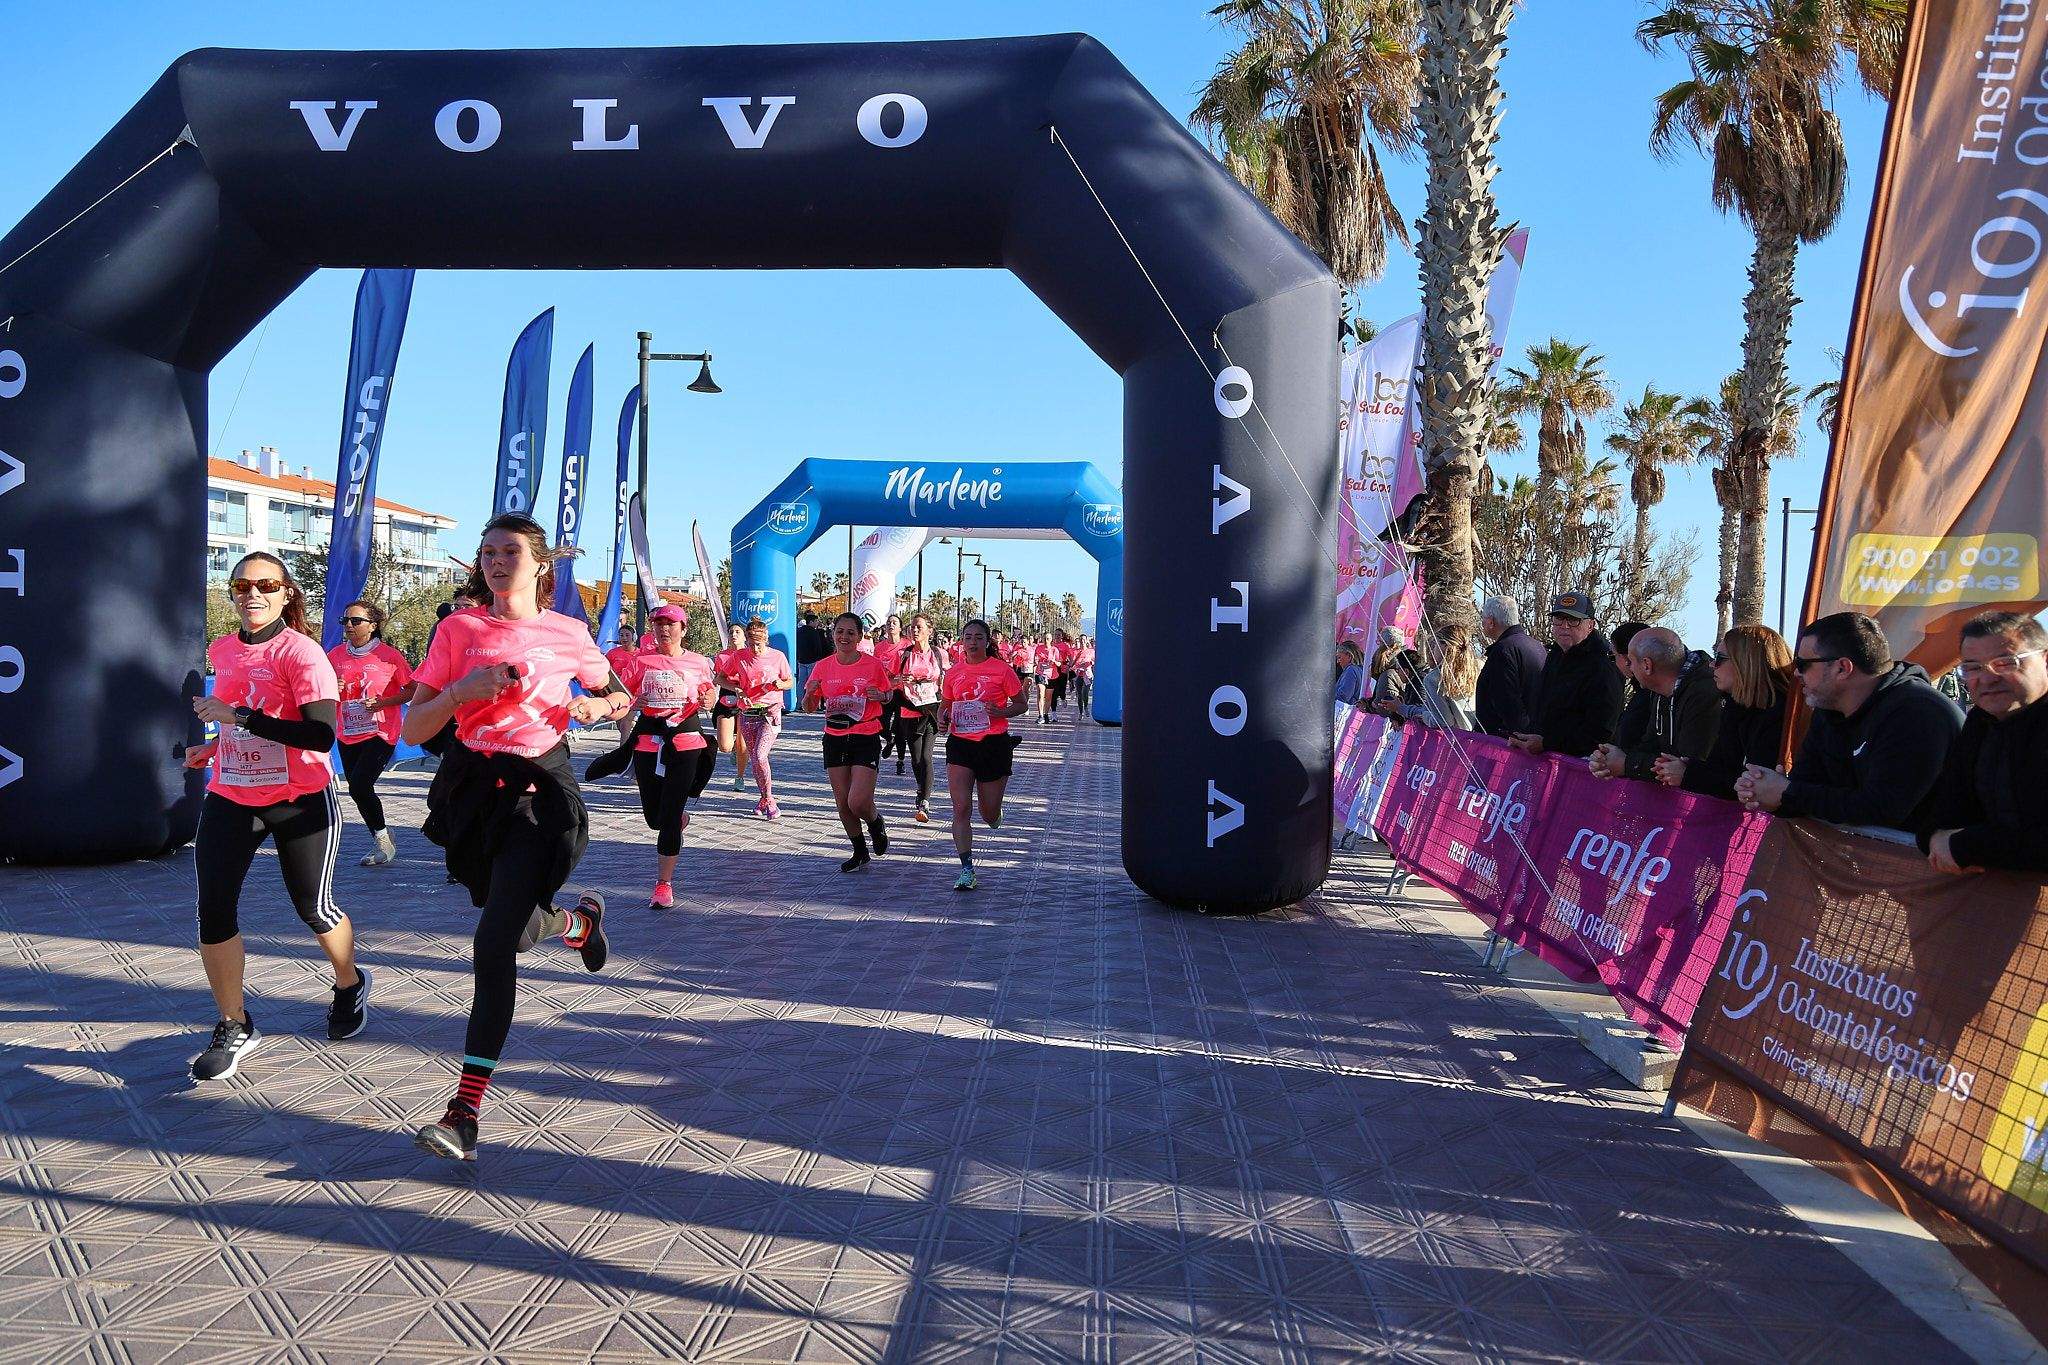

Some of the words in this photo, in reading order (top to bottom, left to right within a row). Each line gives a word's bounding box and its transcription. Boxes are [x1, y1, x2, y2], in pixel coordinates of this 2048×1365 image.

[289, 92, 928, 153] VOLVO
[504, 432, 526, 513] OYA
[884, 466, 1002, 518] Marlene
[1345, 478, 1367, 492] Sal
[770, 508, 806, 526] Marlene
[1085, 510, 1121, 528] Marlene
[1863, 546, 1916, 570] 900
[1960, 547, 2020, 568] 002
[739, 598, 776, 618] Marlene
[1207, 366, 1254, 848] VOLVO
[1457, 780, 1526, 843] renfe
[1448, 840, 1467, 865] TREN
[1466, 851, 1497, 881] OFICIAL
[1566, 827, 1671, 906] renfe
[1554, 897, 1585, 930] TREN
[1582, 913, 1630, 957] OFICIAL
[1791, 937, 1918, 1018] Institutos
[1762, 1036, 1808, 1078] Clínica
[1777, 980, 1976, 1102] Odontológicos
